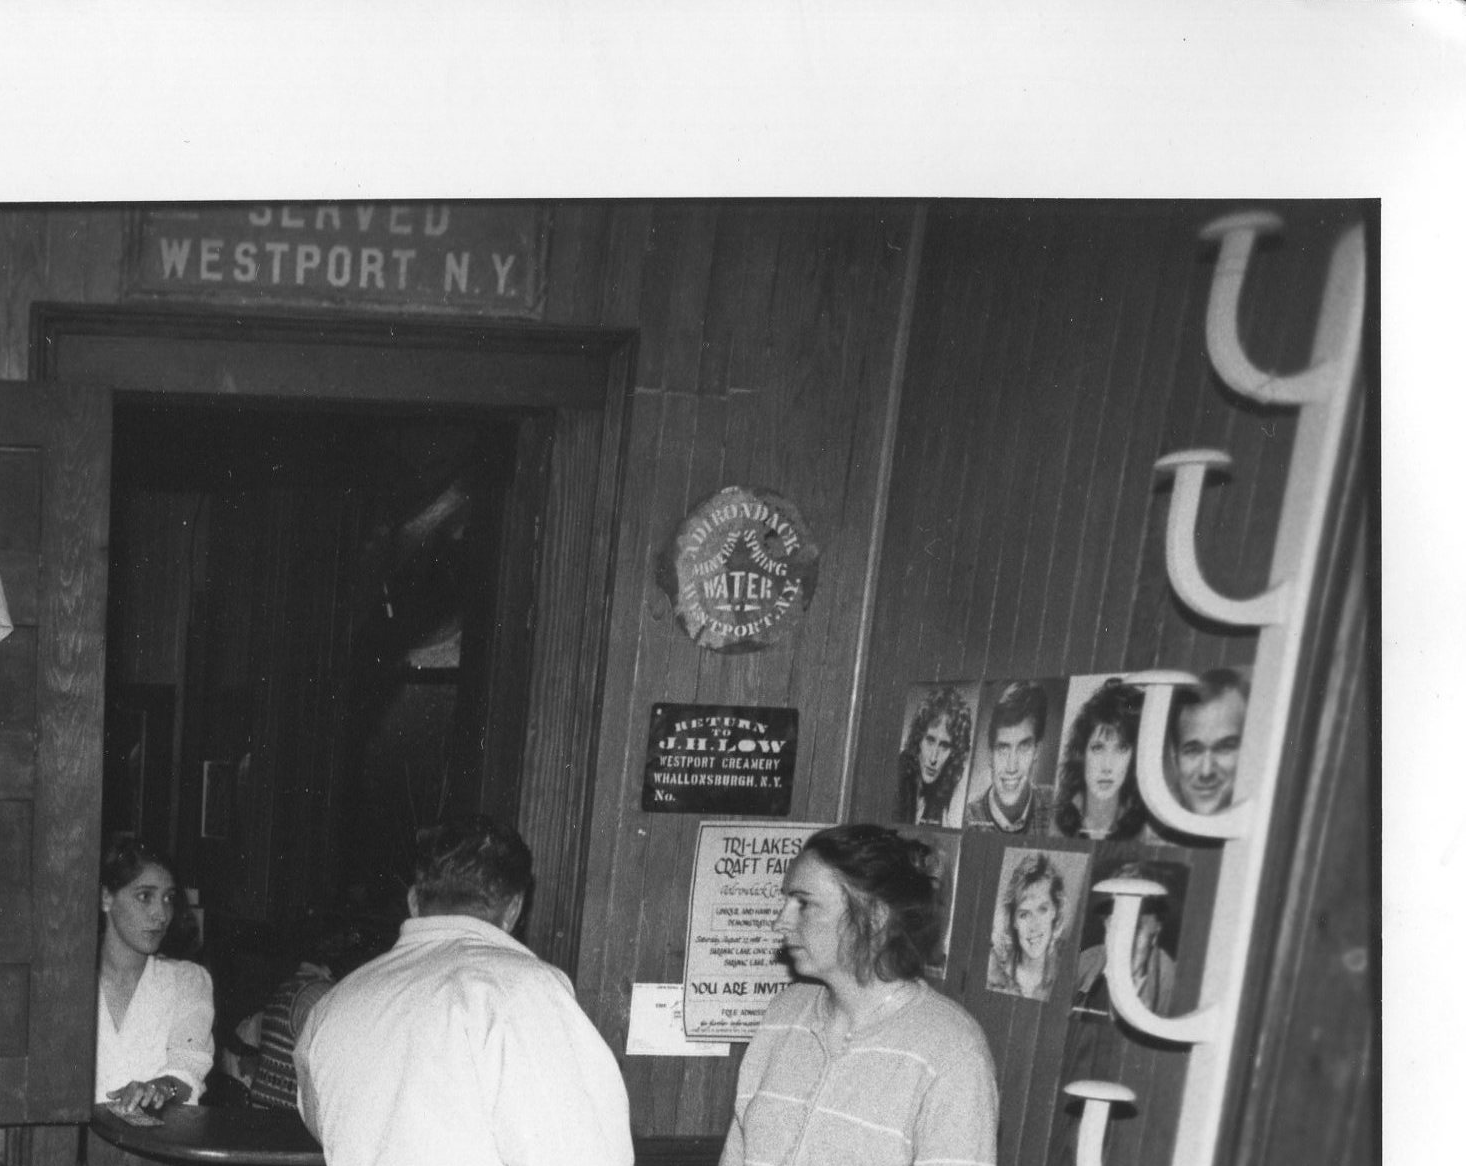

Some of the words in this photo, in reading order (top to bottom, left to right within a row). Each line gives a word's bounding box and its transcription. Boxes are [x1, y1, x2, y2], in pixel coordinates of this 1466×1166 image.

[160, 237, 417, 291] WESTPORT
[743, 529, 788, 576] SPRING
[702, 571, 773, 600] WATER
[674, 716, 770, 734] RETURN
[710, 728, 732, 737] TO
[659, 755, 716, 768] WESTPORT
[721, 758, 782, 770] CREAMERY
[722, 836, 803, 857] TRI-LAKES
[714, 857, 762, 879] CRAFT
[766, 857, 789, 876] FAI
[691, 981, 718, 995] YOU
[722, 981, 749, 996] ARE
[753, 981, 794, 995] INVIT
